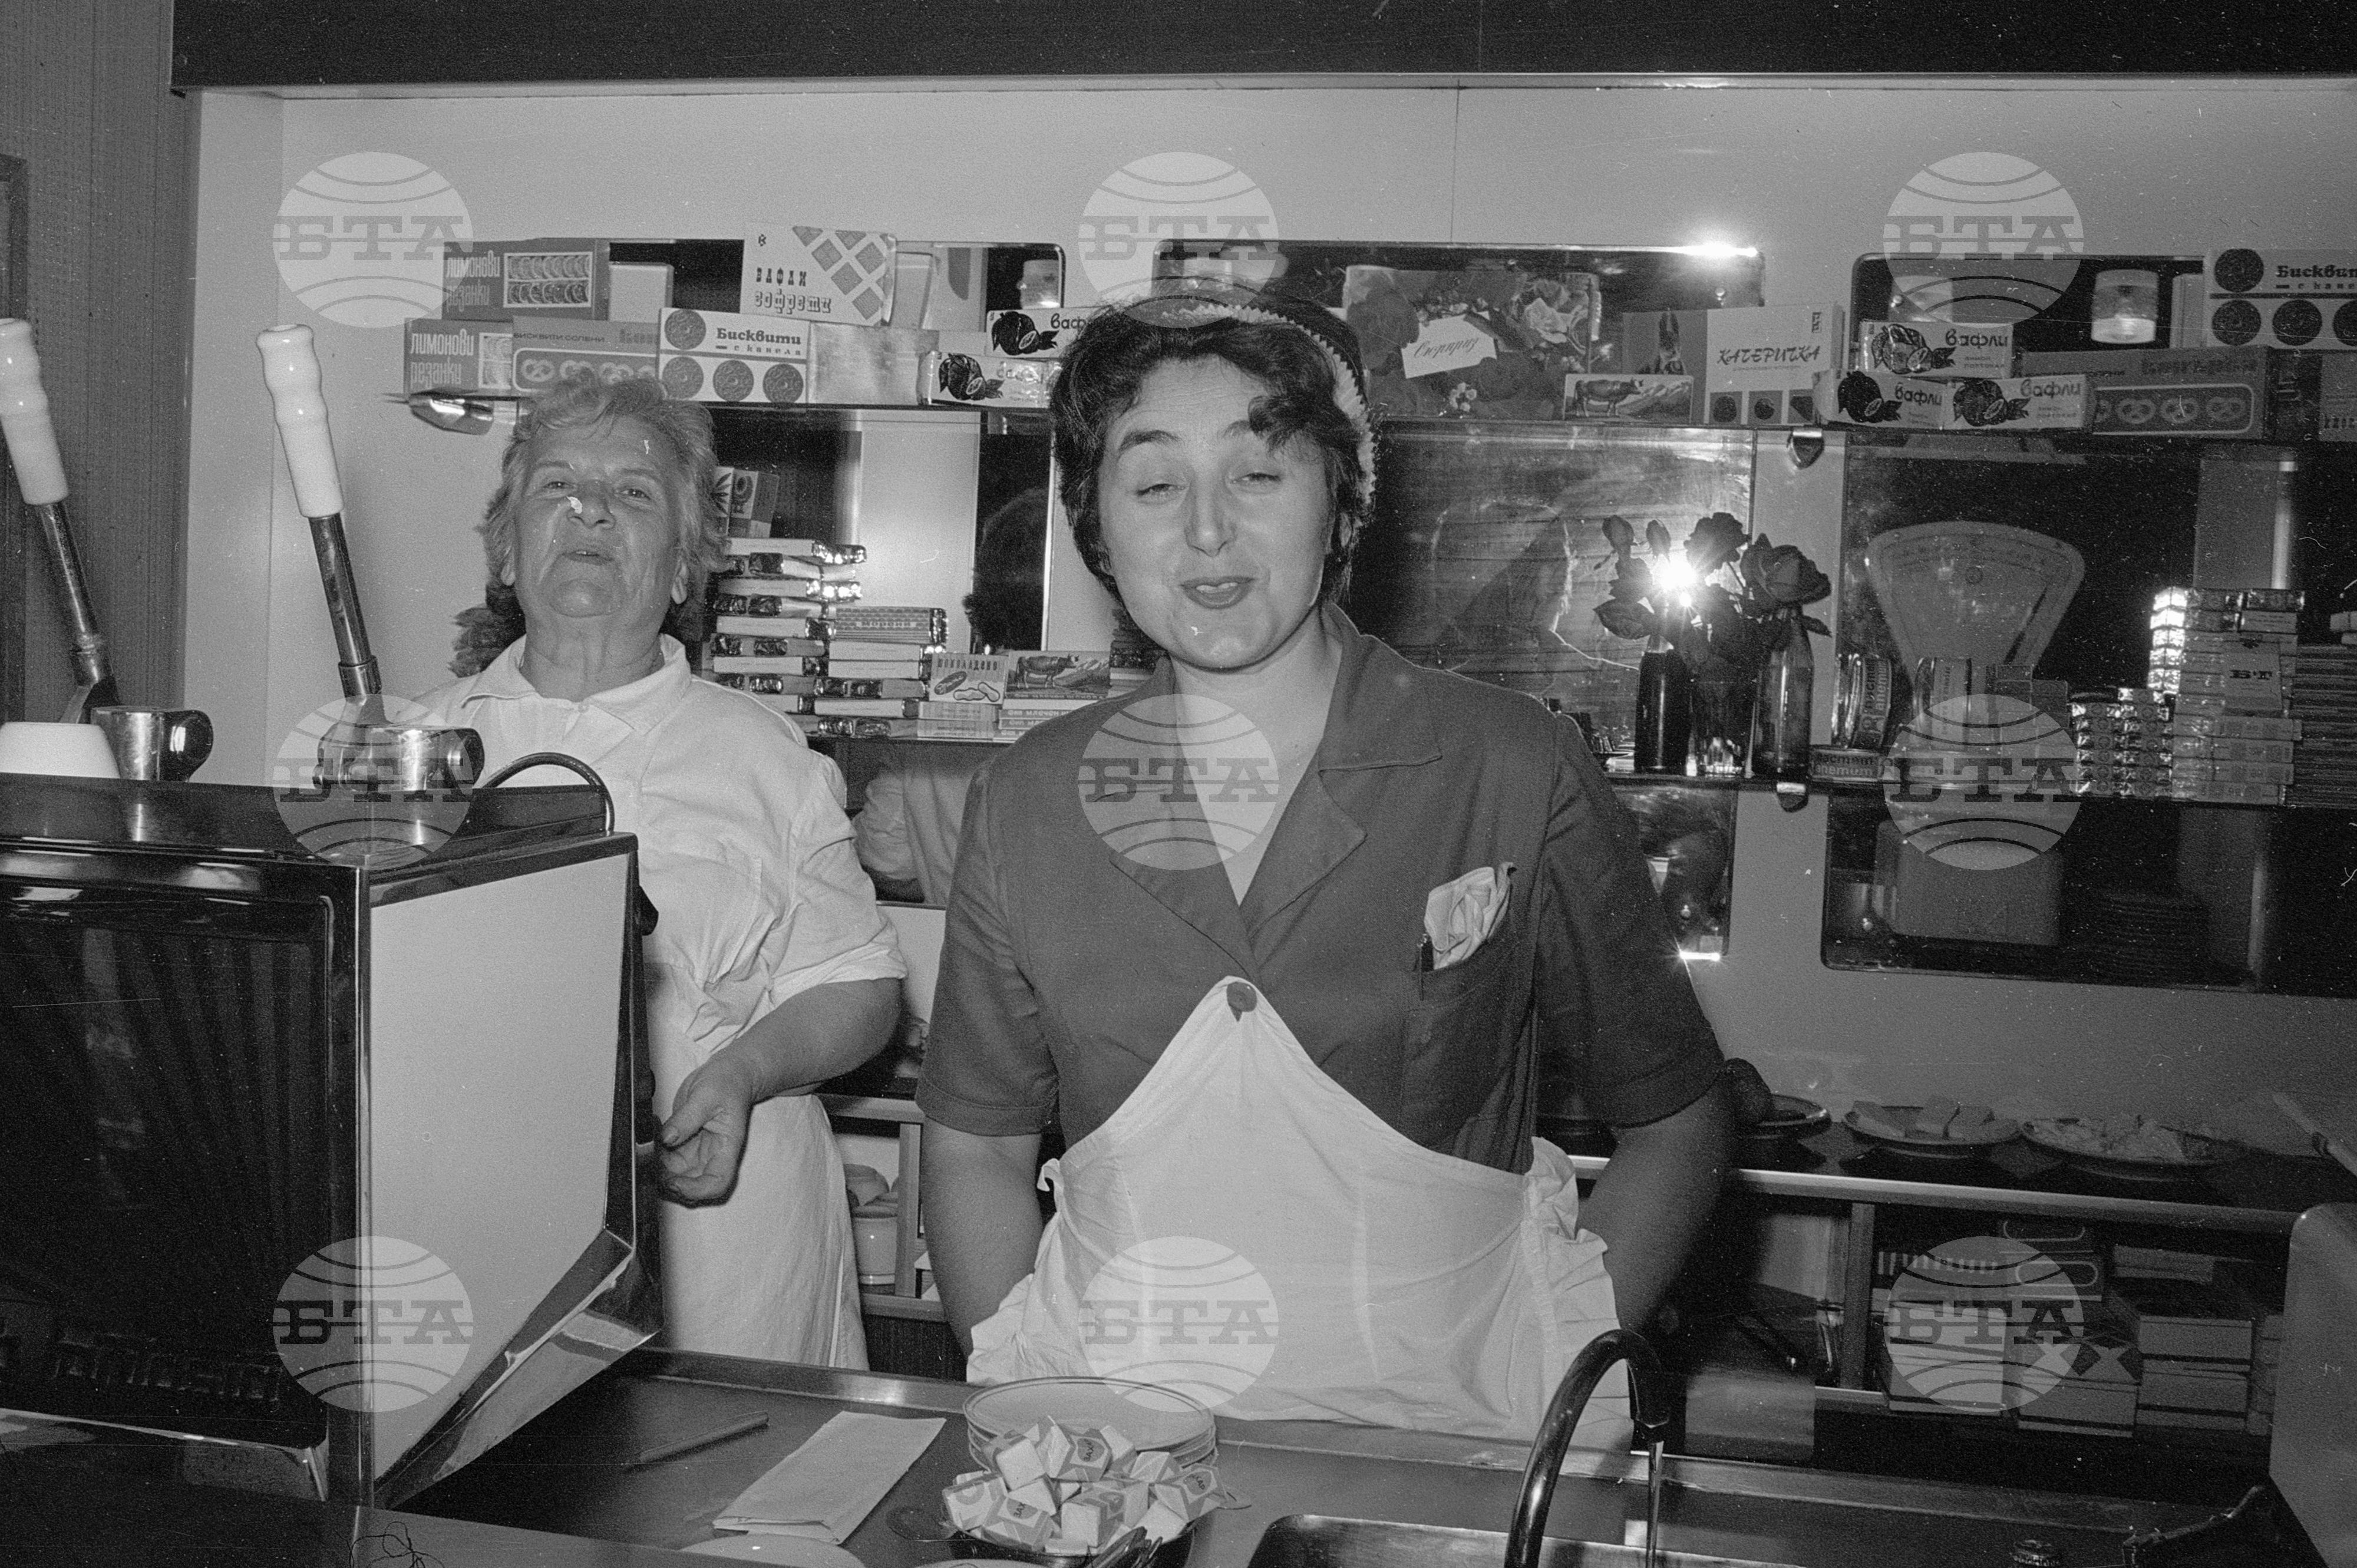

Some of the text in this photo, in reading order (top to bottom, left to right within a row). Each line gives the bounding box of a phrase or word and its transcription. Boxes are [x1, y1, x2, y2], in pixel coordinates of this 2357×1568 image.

[411, 328, 474, 355] лимонови
[717, 328, 801, 345] Бисквити
[1946, 328, 2008, 349] вафли
[1894, 382, 1943, 406] вафли
[2020, 378, 2081, 398] вафли
